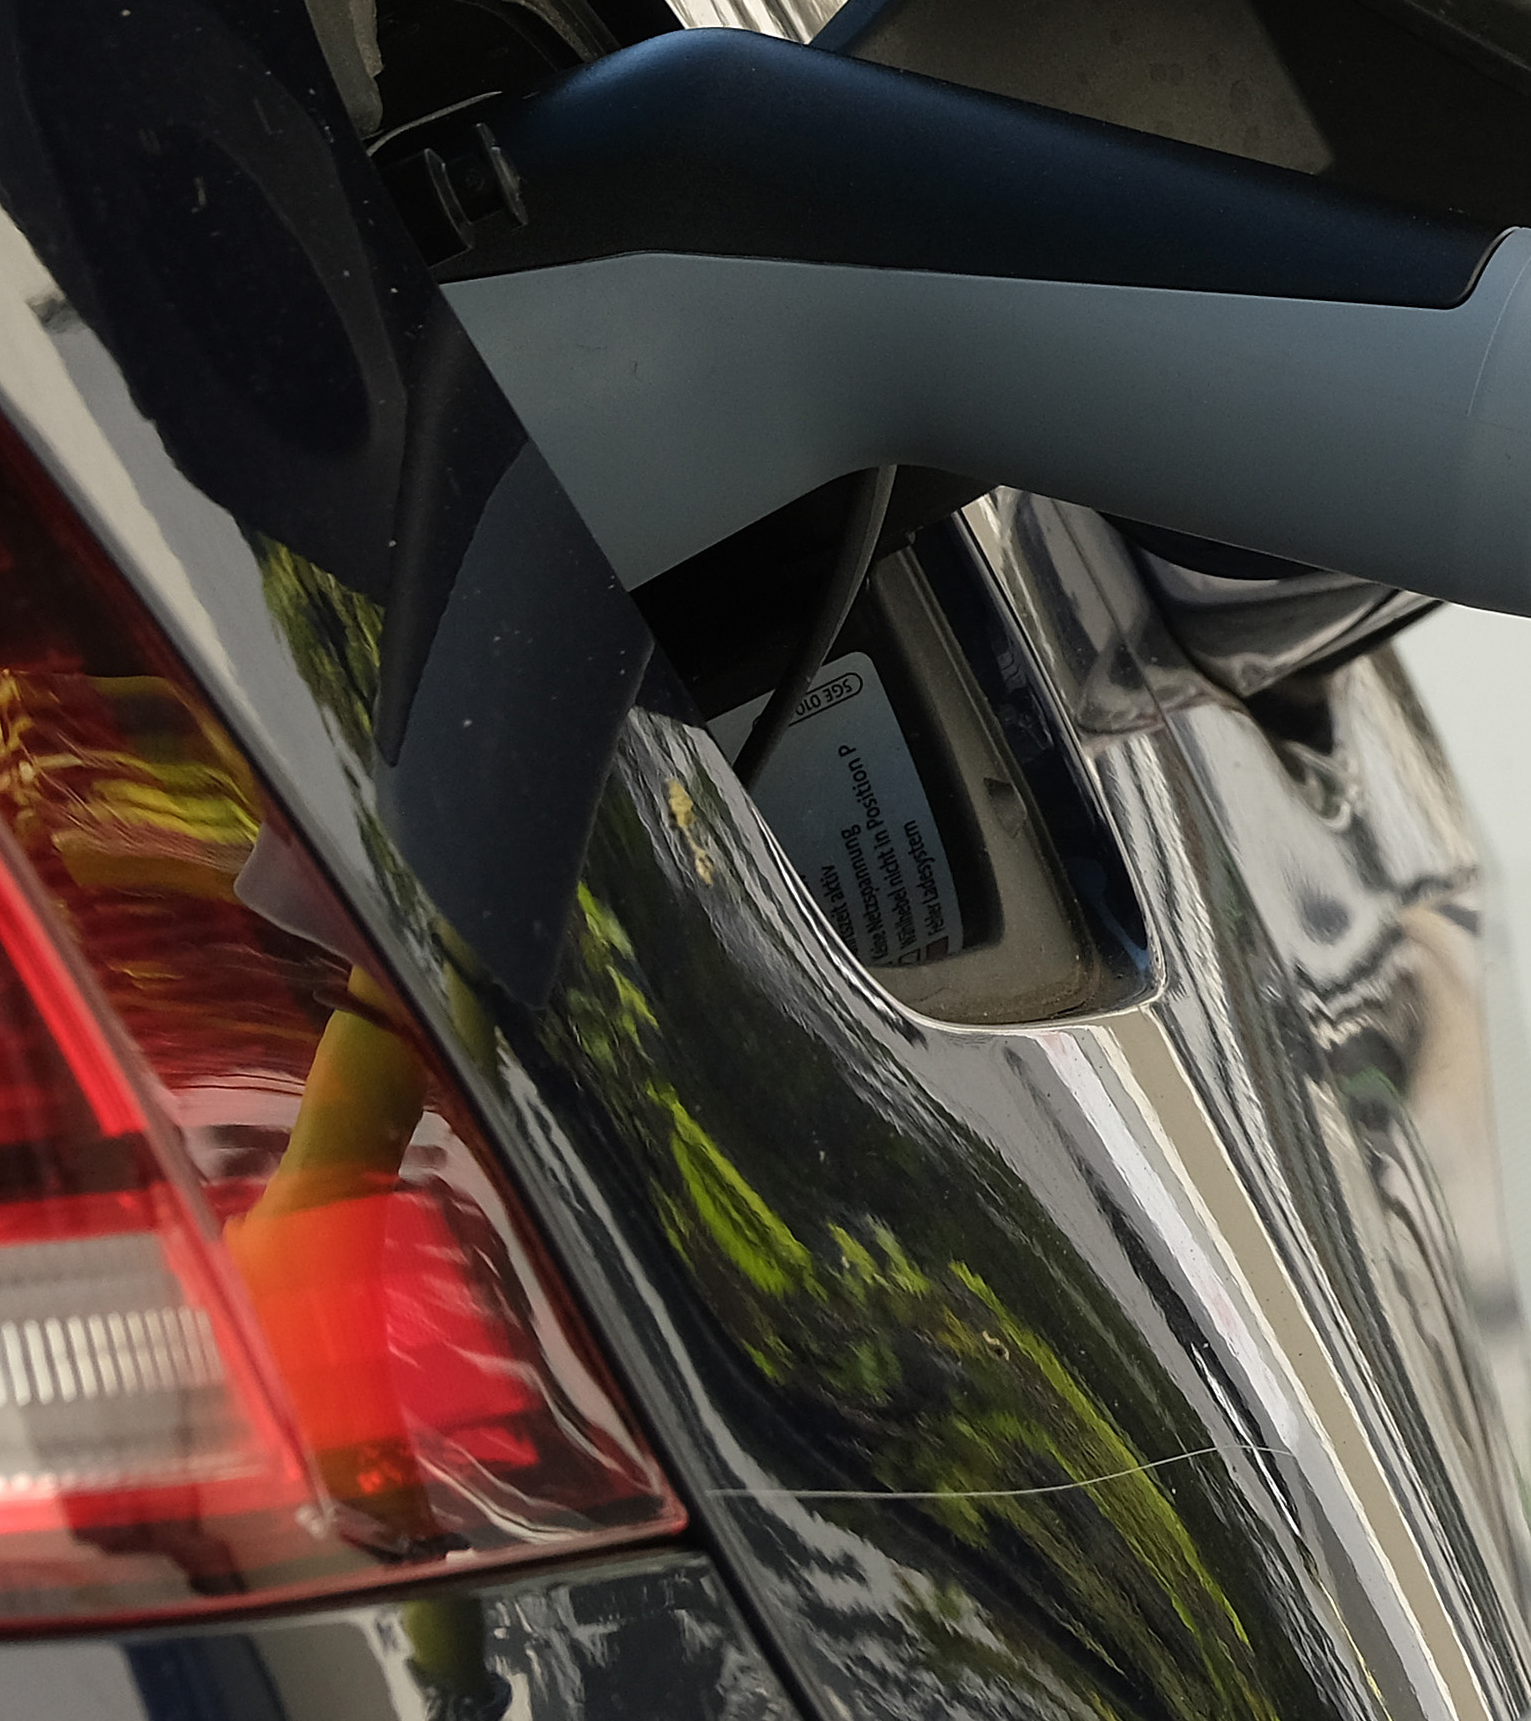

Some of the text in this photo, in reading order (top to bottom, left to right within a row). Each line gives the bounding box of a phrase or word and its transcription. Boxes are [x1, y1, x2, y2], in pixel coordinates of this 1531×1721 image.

[837, 744, 857, 758] P
[848, 757, 884, 830] Position
[874, 829, 892, 850] in
[841, 824, 884, 934] Netzspannung
[878, 846, 904, 887] nicht
[904, 819, 939, 905] Ladesystem
[821, 864, 845, 904] aktiv
